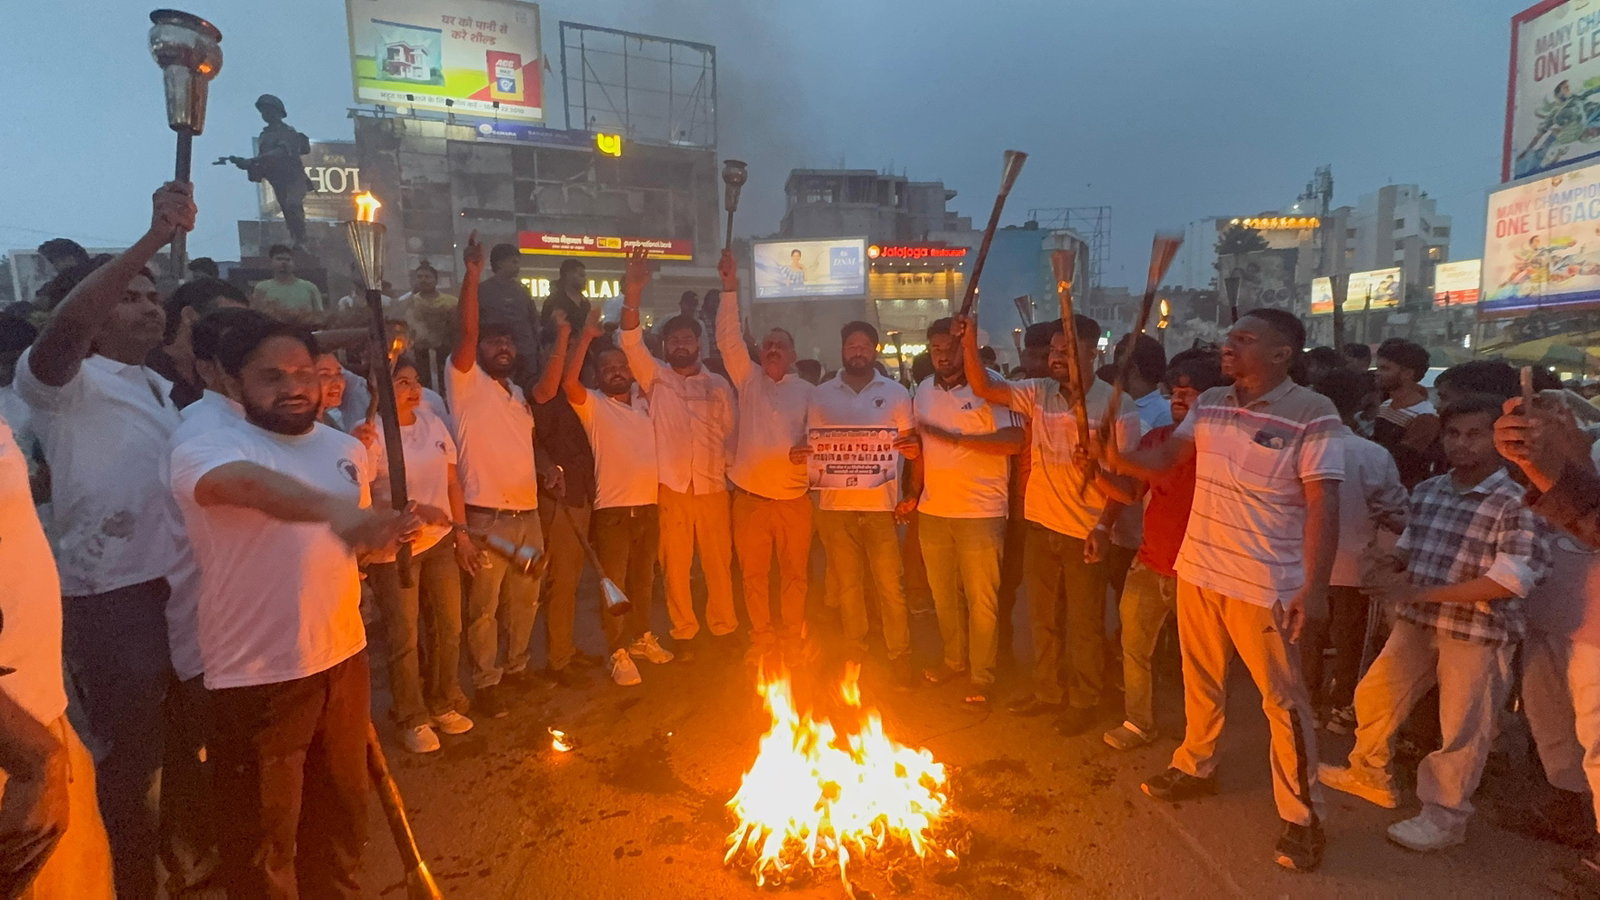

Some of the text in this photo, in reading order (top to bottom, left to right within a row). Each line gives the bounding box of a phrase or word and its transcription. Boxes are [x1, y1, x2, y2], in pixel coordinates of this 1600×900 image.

[441, 14, 456, 25] घर
[458, 16, 473, 28] को
[475, 20, 497, 32] पानी
[470, 32, 497, 46] शील्ड
[1535, 22, 1573, 55] MANY
[1534, 43, 1572, 82] ONE
[1497, 200, 1531, 219] MANY
[1496, 214, 1530, 238] ONE
[881, 241, 928, 258] Jalajoga
